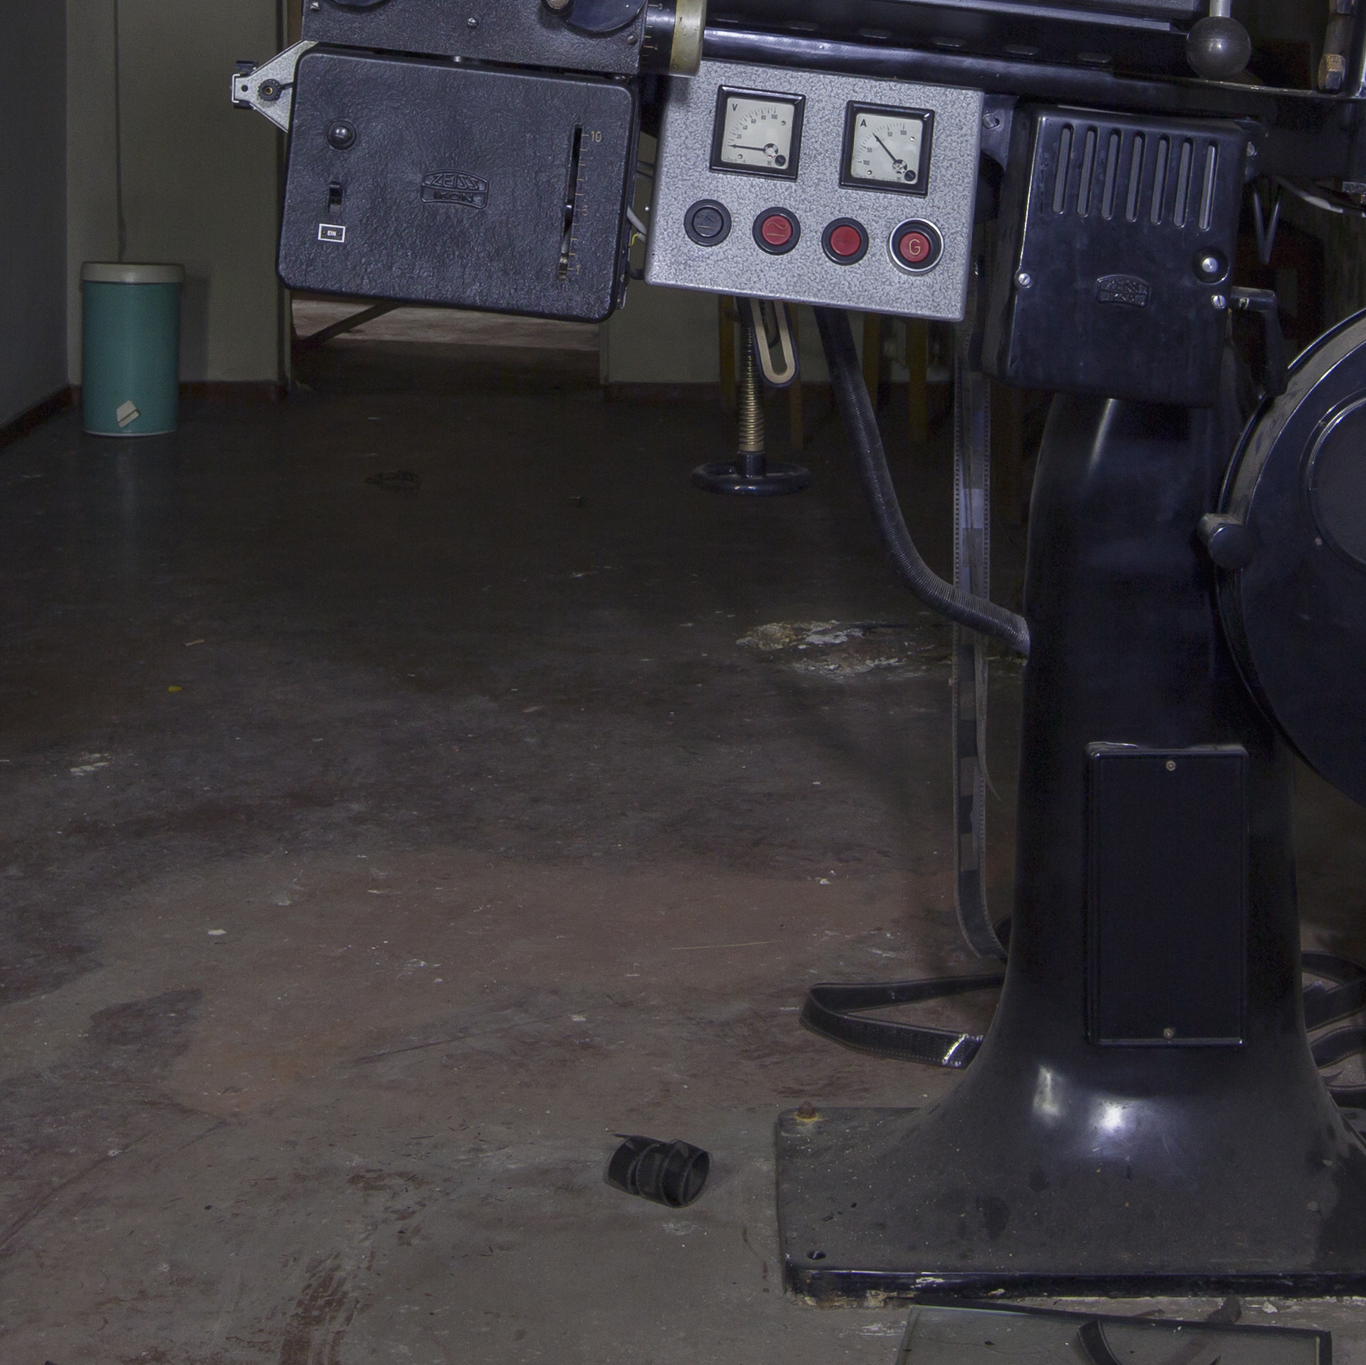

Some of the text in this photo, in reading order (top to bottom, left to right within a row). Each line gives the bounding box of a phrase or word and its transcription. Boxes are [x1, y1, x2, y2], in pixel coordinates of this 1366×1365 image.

[732, 103, 738, 112] V
[860, 118, 867, 127] A
[591, 130, 602, 143] 10
[431, 173, 479, 191] ZEISS
[433, 190, 474, 203] IKON
[908, 238, 921, 256] G
